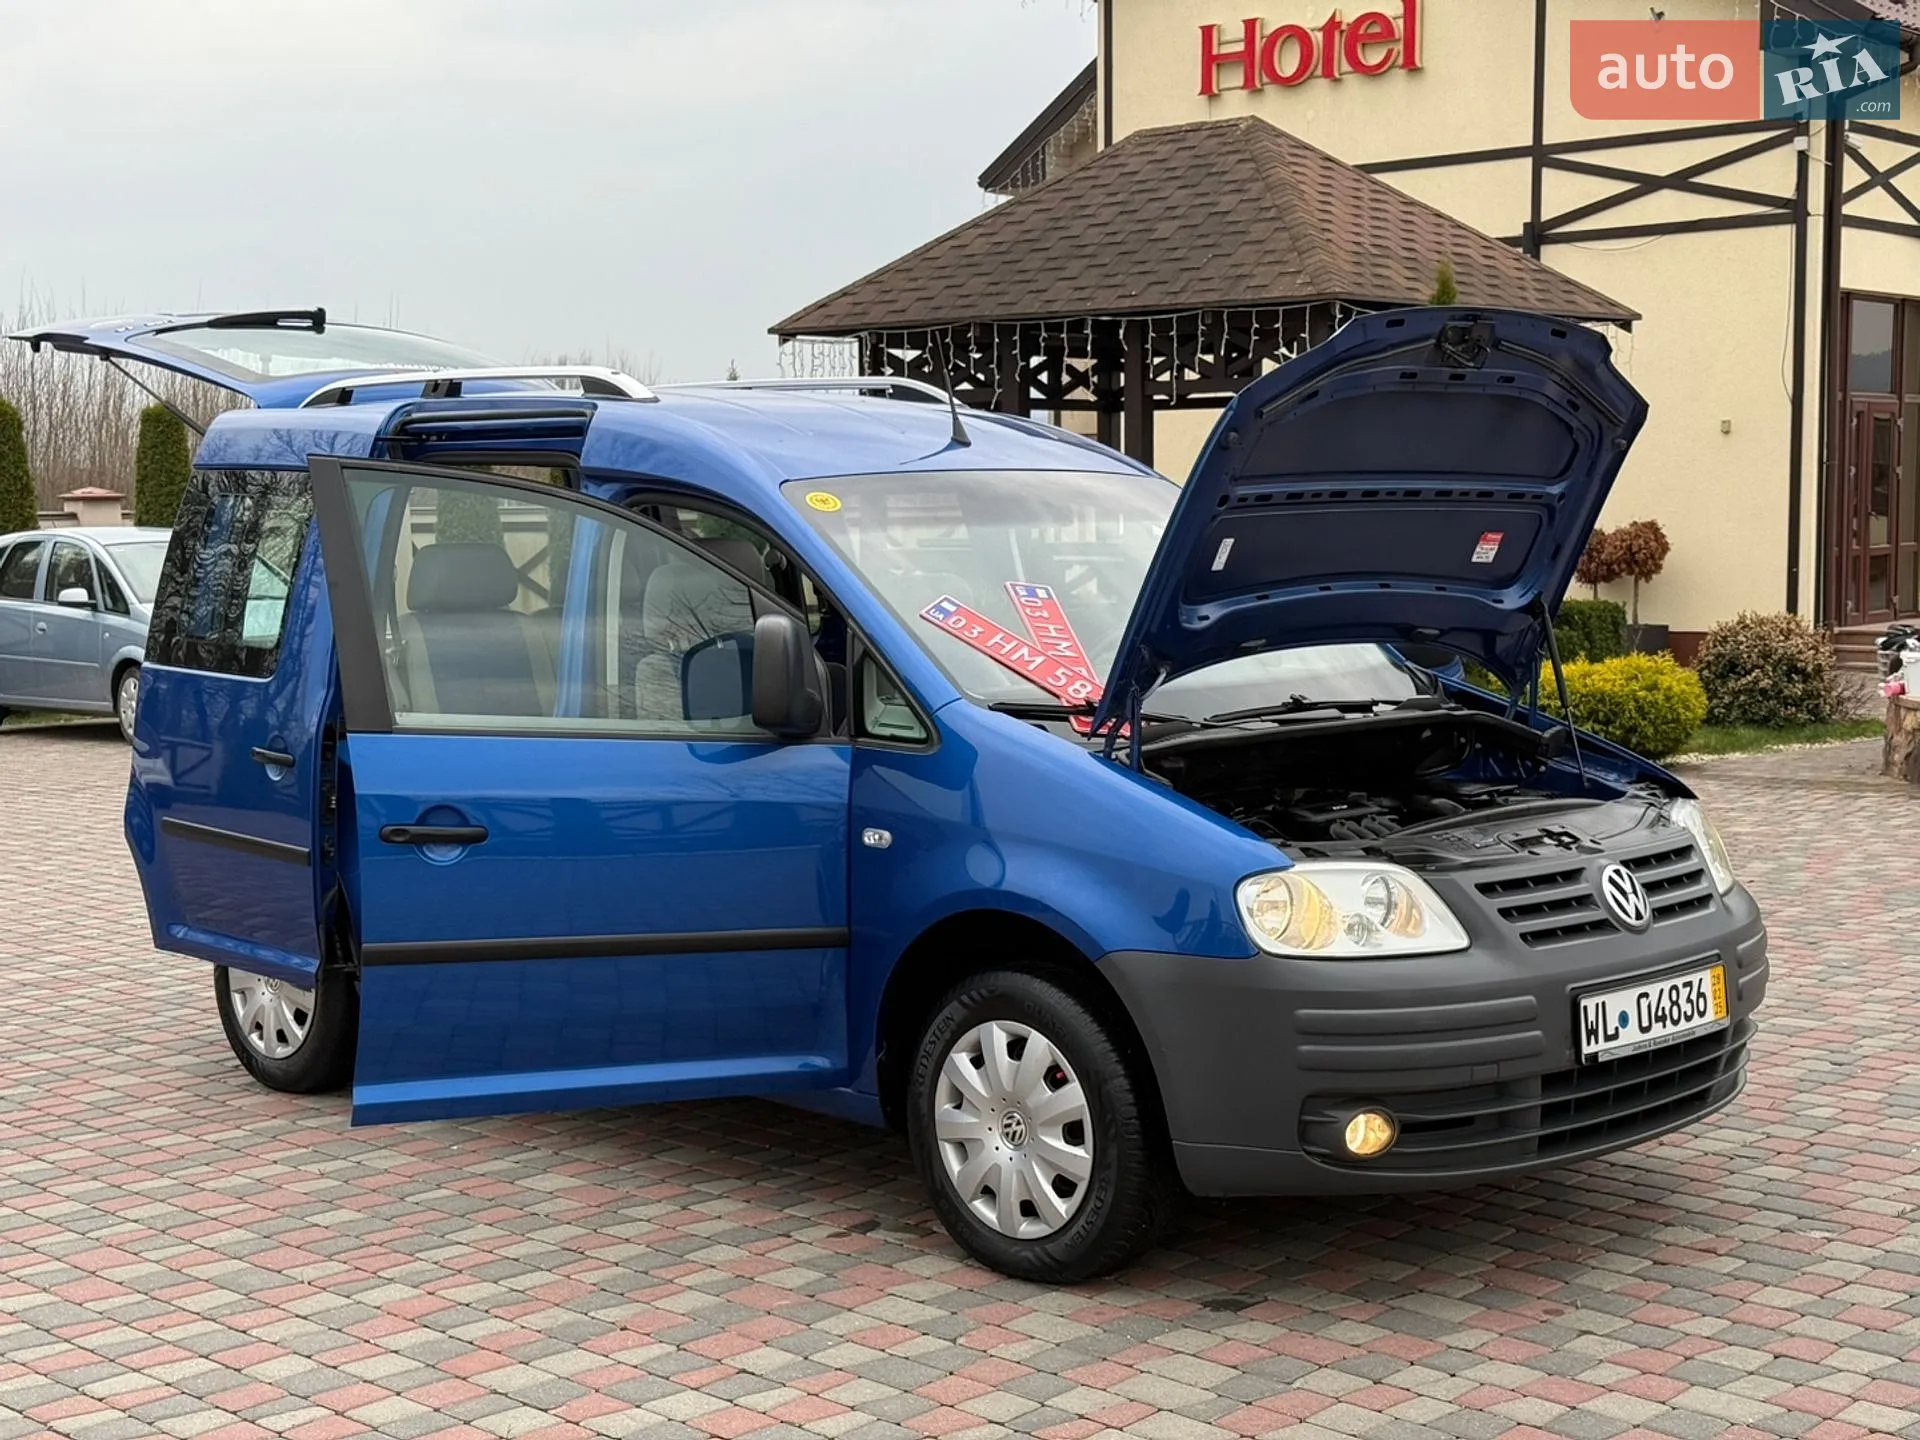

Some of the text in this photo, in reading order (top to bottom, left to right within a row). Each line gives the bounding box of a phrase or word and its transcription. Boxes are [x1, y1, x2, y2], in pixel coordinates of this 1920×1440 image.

[1197, 0, 1421, 96] Hotel
[947, 615, 985, 638] 03
[984, 632, 1047, 671] HM
[1020, 597, 1078, 657] 03 HM
[1583, 977, 1707, 1047] WL 04836
[912, 1011, 955, 1090] REDESTEIN
